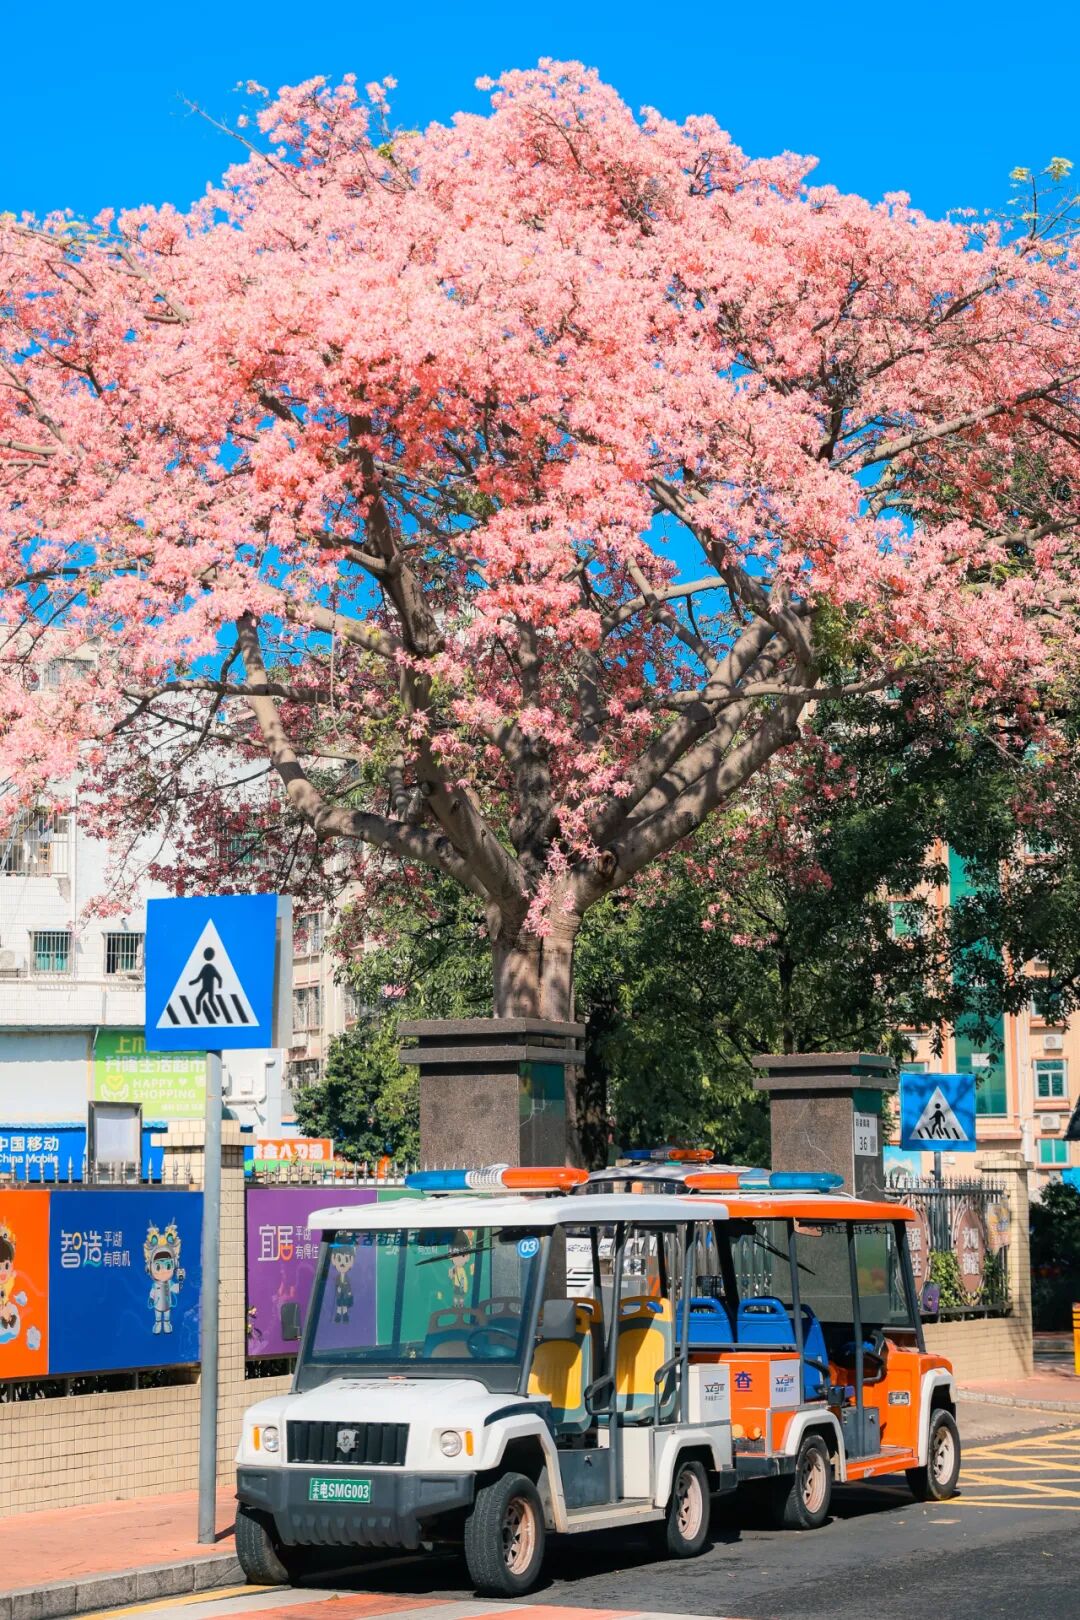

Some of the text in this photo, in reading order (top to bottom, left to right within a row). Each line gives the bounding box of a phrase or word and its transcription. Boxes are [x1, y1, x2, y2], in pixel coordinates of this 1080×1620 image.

[132, 1079, 174, 1089] HAPPY
[132, 1090, 196, 1100] SHOPPING
[859, 1136, 868, 1151] 36
[25, 1154, 59, 1164] Mobile
[103, 1230, 123, 1248] 平湖
[258, 1224, 294, 1262] 宜居
[520, 1240, 537, 1253] 03
[61, 1229, 102, 1268] 智造
[103, 1250, 131, 1268] 有商机
[320, 1481, 370, 1499] 电SMG003
